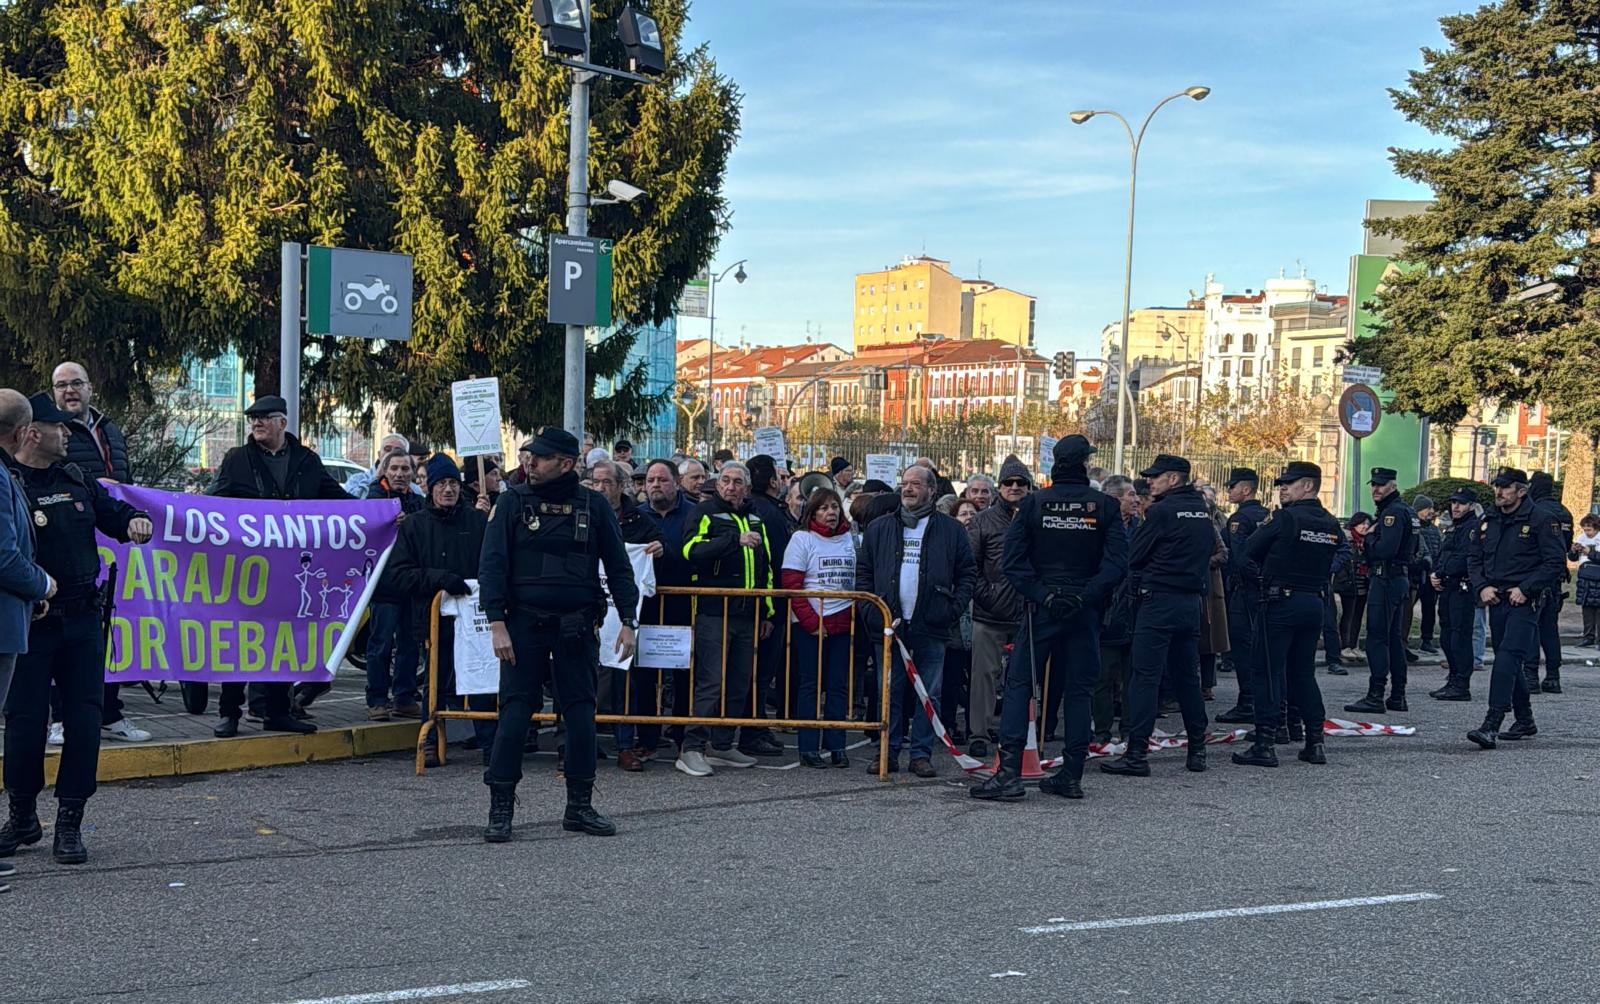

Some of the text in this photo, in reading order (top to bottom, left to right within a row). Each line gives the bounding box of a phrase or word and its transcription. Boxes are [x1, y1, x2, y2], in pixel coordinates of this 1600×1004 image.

[564, 261, 583, 290] P
[1042, 515, 1087, 524] POLICIA
[1176, 511, 1209, 519] POLICIA
[163, 504, 367, 550] LOS SANTOS
[1042, 522, 1097, 531] NACIONAL
[903, 540, 920, 548] URO
[822, 558, 843, 567] MURO
